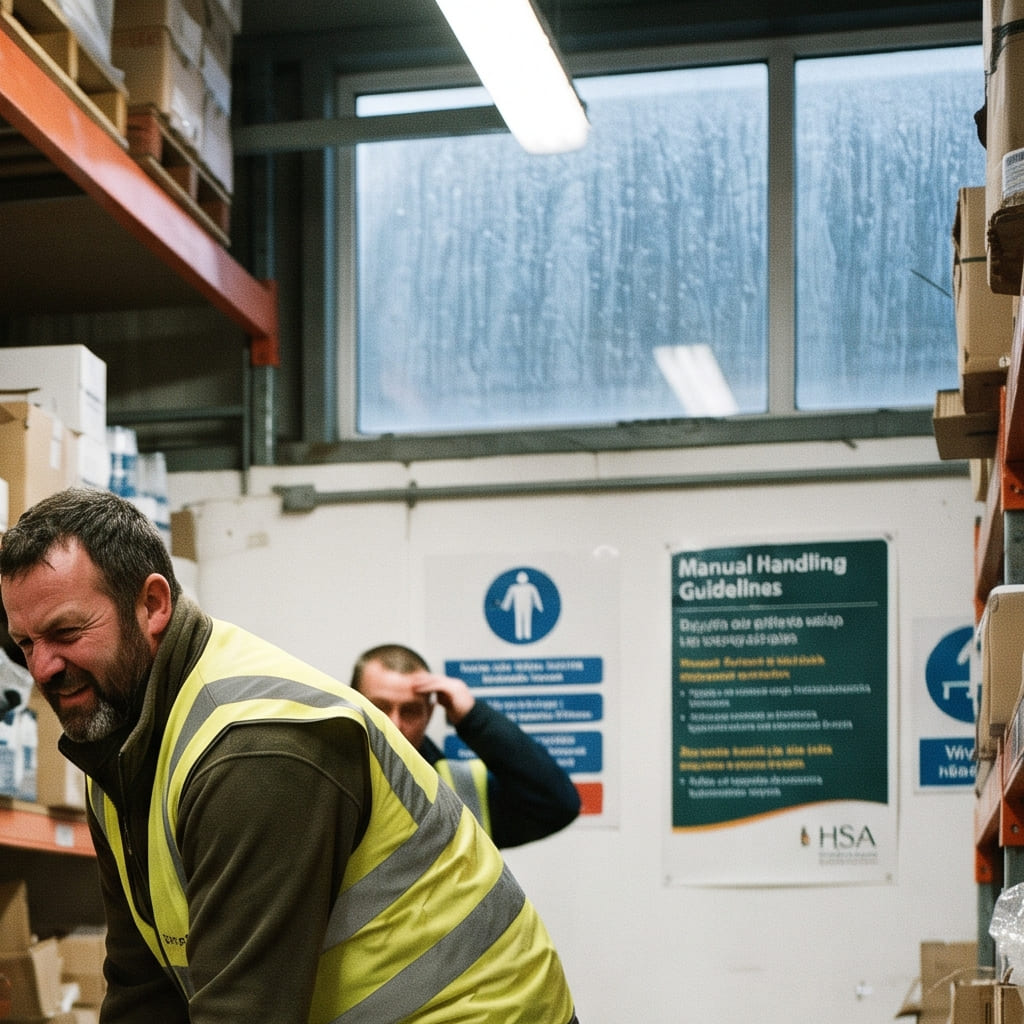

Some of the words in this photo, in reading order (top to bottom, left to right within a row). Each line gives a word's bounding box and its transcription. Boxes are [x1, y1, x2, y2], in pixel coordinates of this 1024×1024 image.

[678, 554, 753, 578] Manual
[757, 552, 847, 576] Handling
[678, 578, 783, 601] Guidelines
[819, 825, 877, 849] HSA
